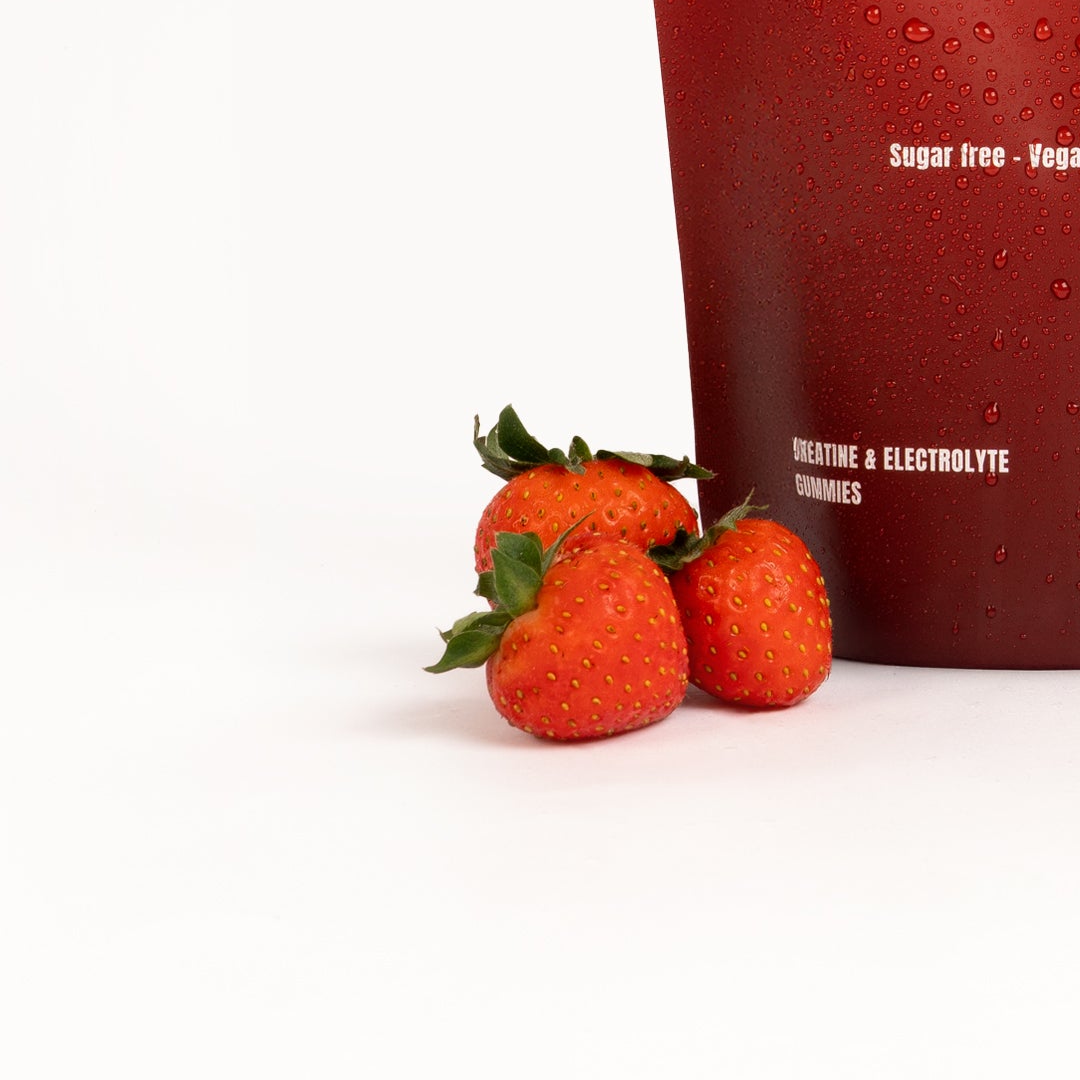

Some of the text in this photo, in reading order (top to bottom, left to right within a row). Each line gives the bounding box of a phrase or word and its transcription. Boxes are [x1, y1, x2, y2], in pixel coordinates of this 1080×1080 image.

[889, 143, 953, 170] Sugar
[864, 448, 877, 470] &
[883, 447, 1010, 473] ELECTROLYTE
[795, 473, 862, 505] GUMMIES
